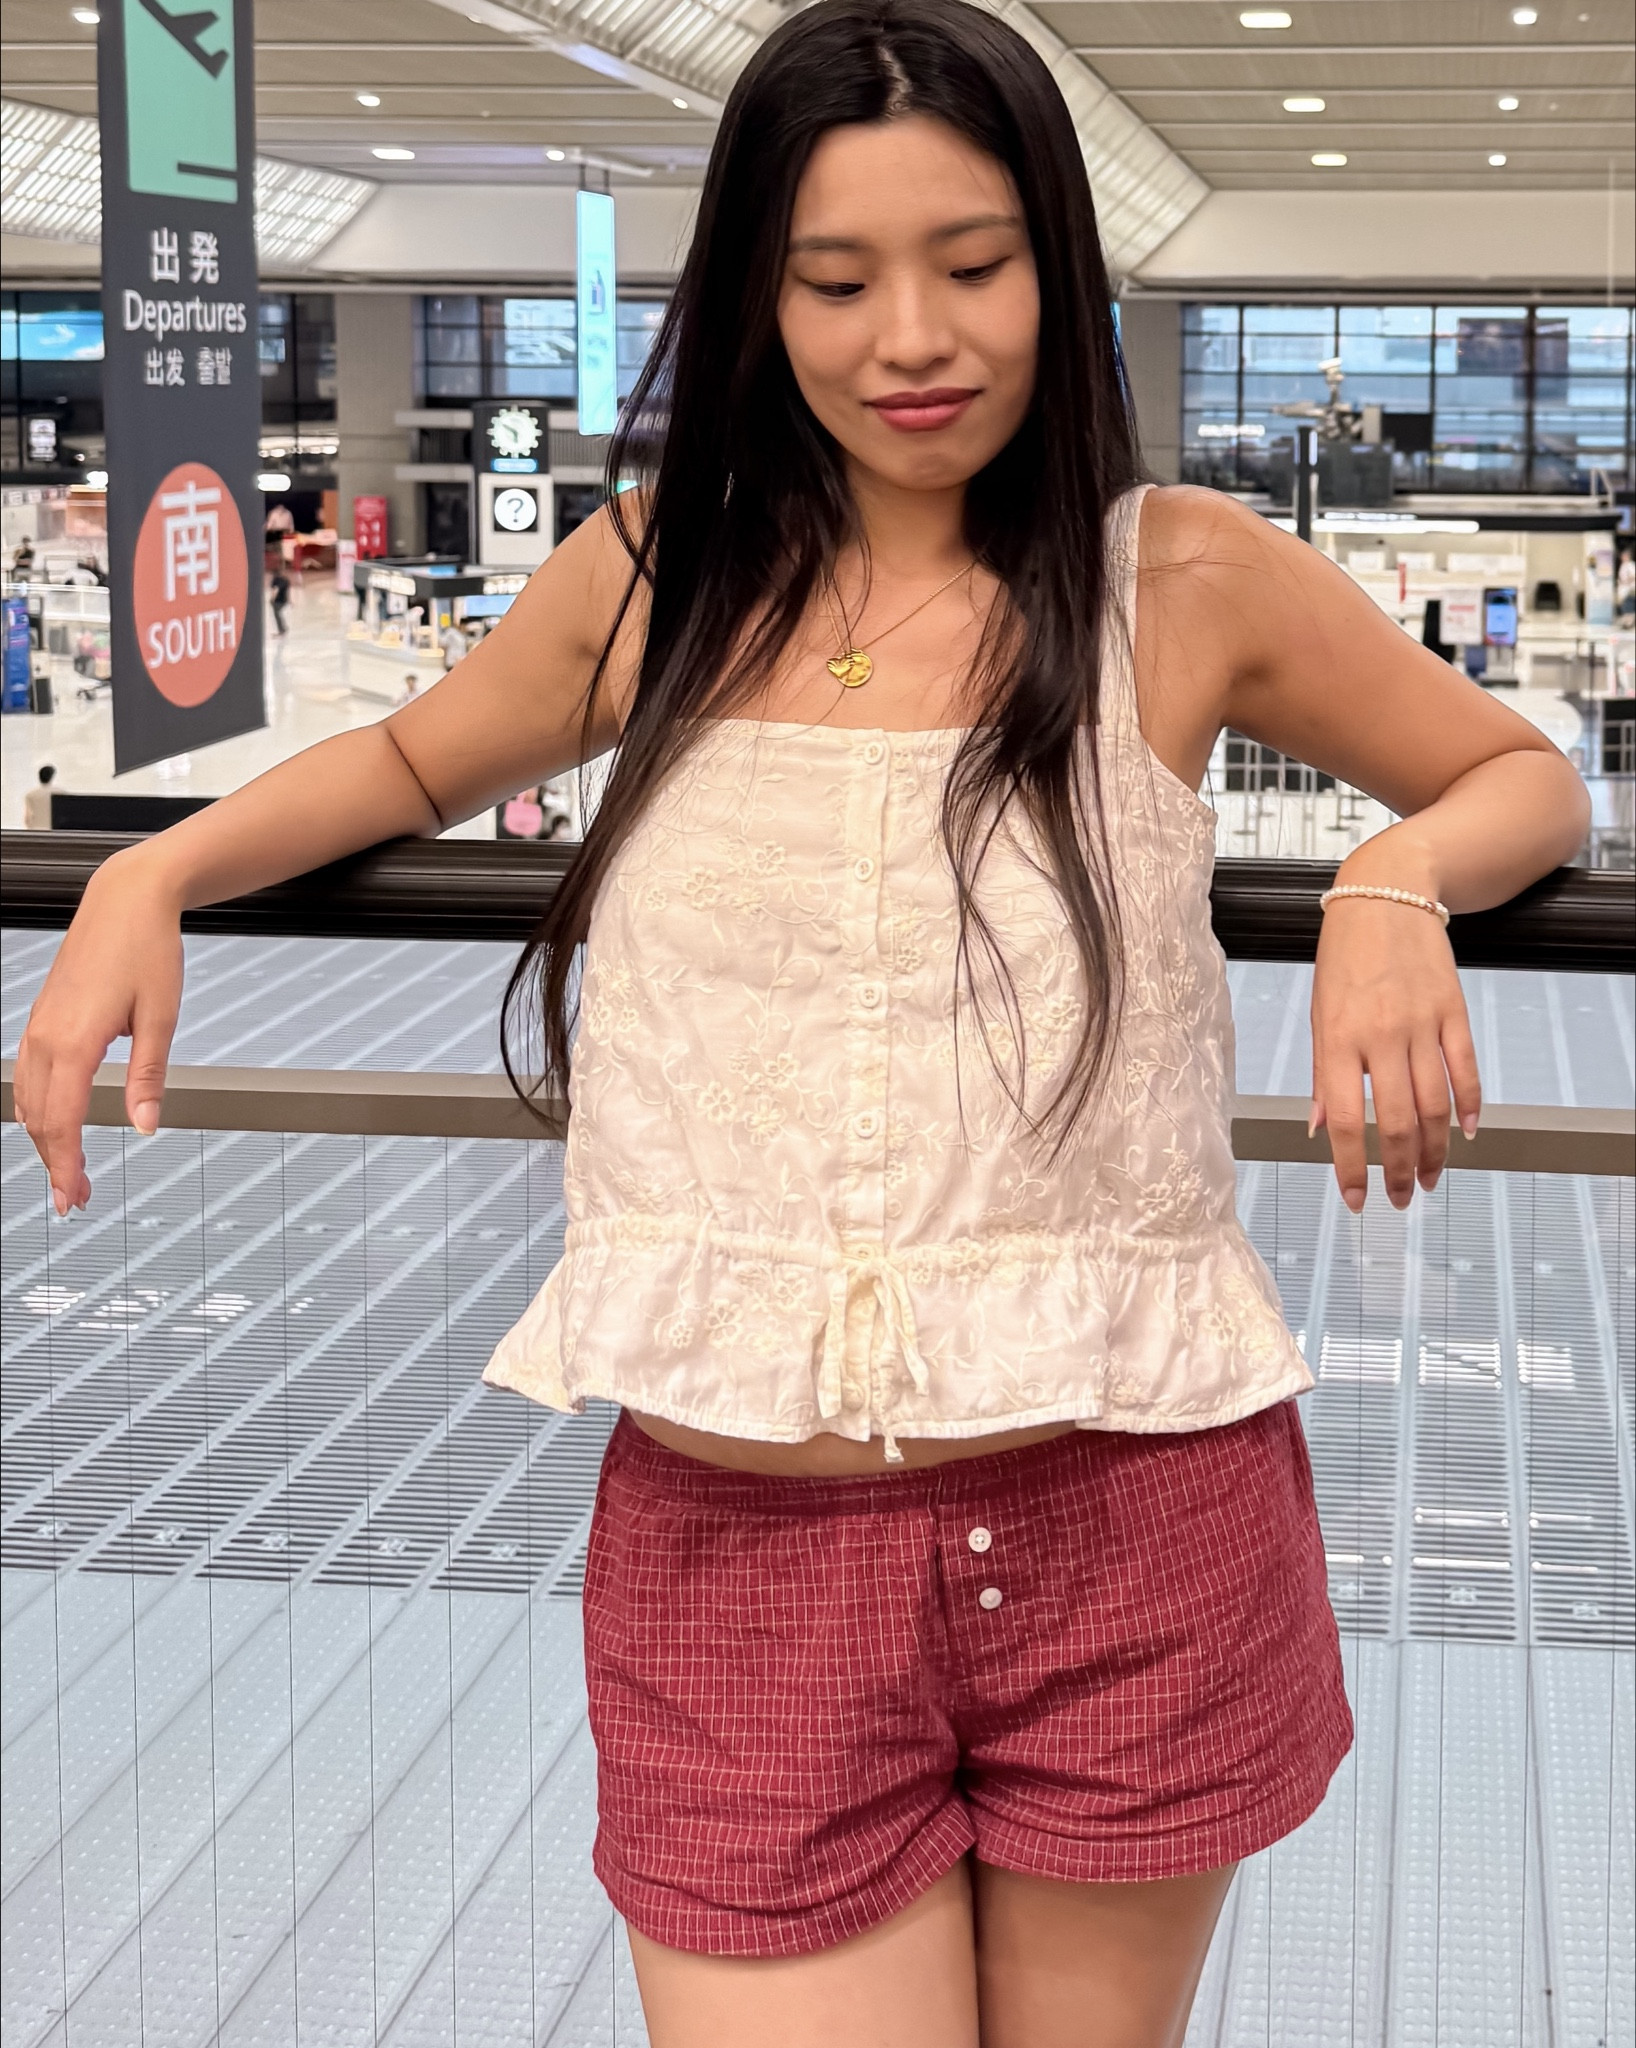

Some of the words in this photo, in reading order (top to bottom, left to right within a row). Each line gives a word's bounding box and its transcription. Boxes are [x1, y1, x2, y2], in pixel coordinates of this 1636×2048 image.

[152, 226, 220, 284] 出発
[122, 288, 247, 342] Departures
[145, 347, 186, 386] 出发
[160, 480, 222, 602] 南
[148, 606, 237, 669] SOUTH
